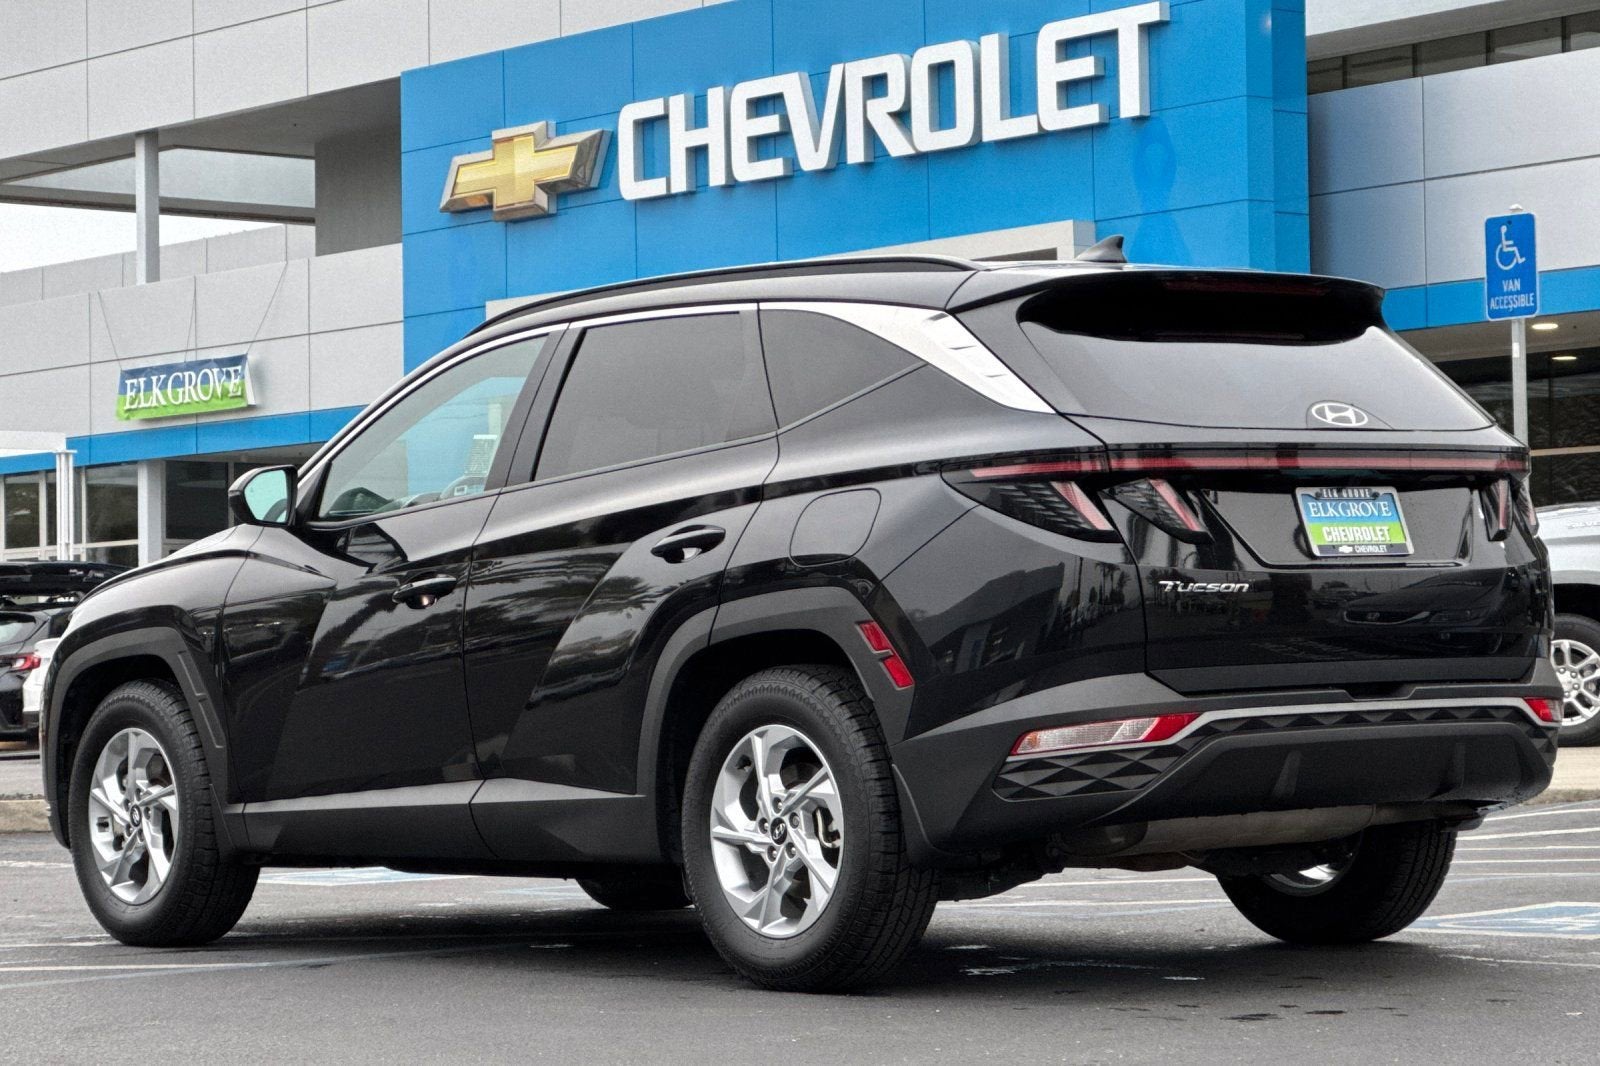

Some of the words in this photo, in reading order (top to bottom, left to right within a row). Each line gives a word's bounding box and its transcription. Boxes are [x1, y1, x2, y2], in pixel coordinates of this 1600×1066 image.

[618, 1, 1169, 200] CHEVROLET
[1502, 279, 1521, 292] VAN
[1490, 293, 1534, 310] ACCESSIBLE
[1323, 488, 1339, 498] ELK
[1342, 488, 1370, 498] GROVE
[1322, 526, 1391, 542] CHEVROLET
[1354, 545, 1387, 553] CHEVROLET
[1159, 580, 1249, 592] Tucson
